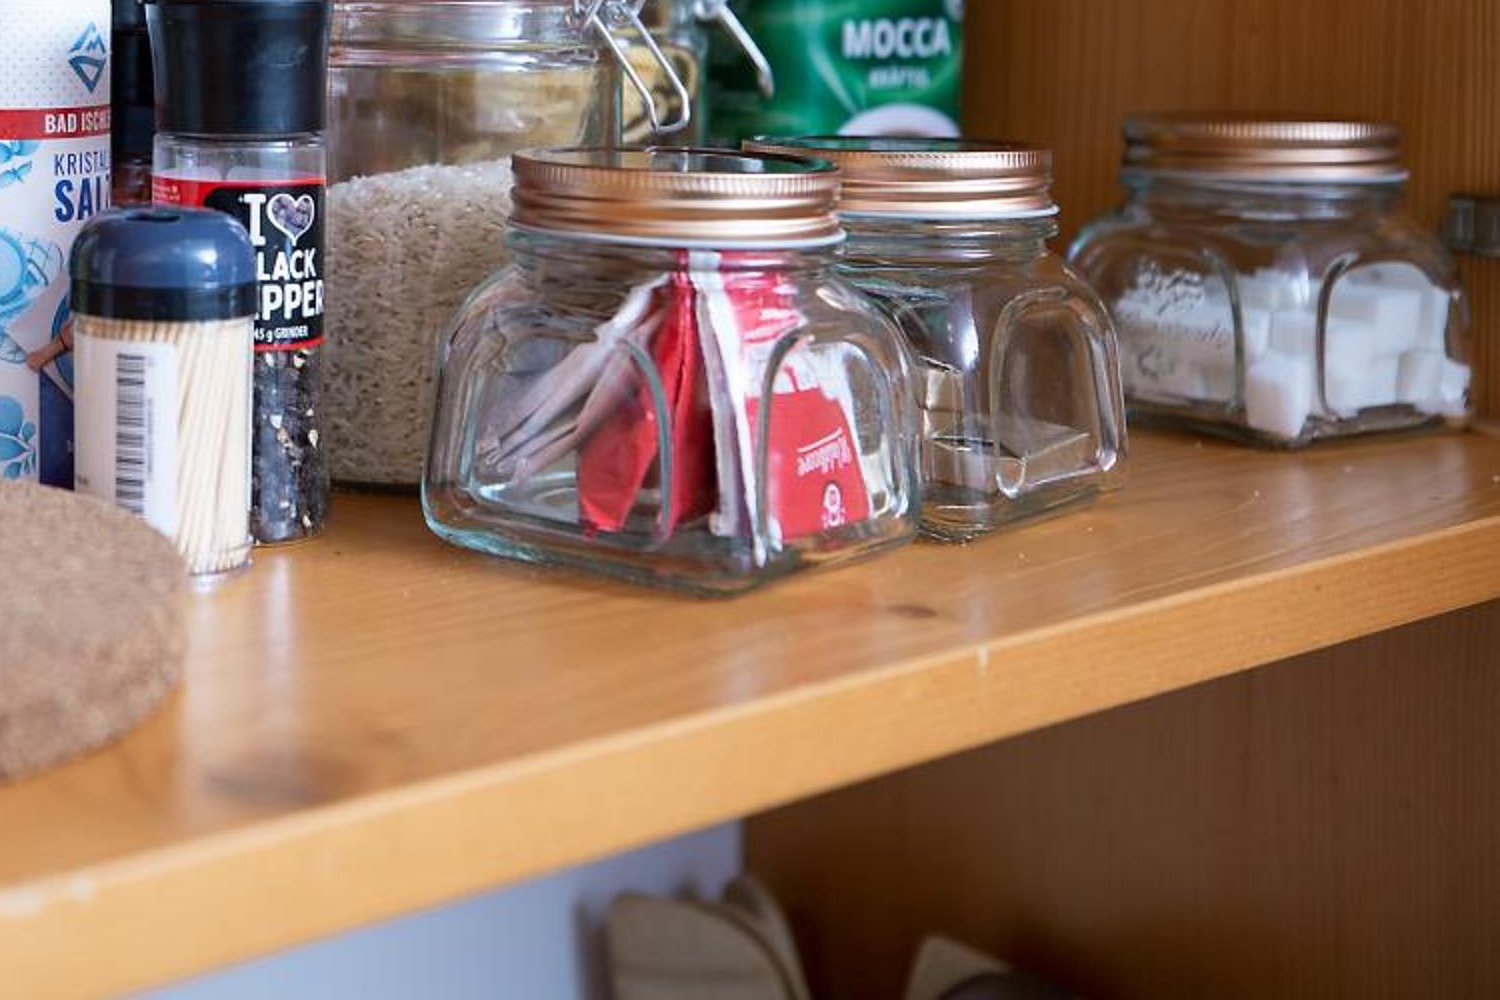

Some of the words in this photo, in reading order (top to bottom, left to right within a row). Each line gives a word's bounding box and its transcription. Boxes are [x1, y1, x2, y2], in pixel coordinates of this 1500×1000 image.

[842, 17, 950, 58] MOCCA
[44, 113, 76, 133] BAD
[243, 193, 267, 247] I
[257, 248, 316, 281] LACK
[255, 279, 325, 321] PPER
